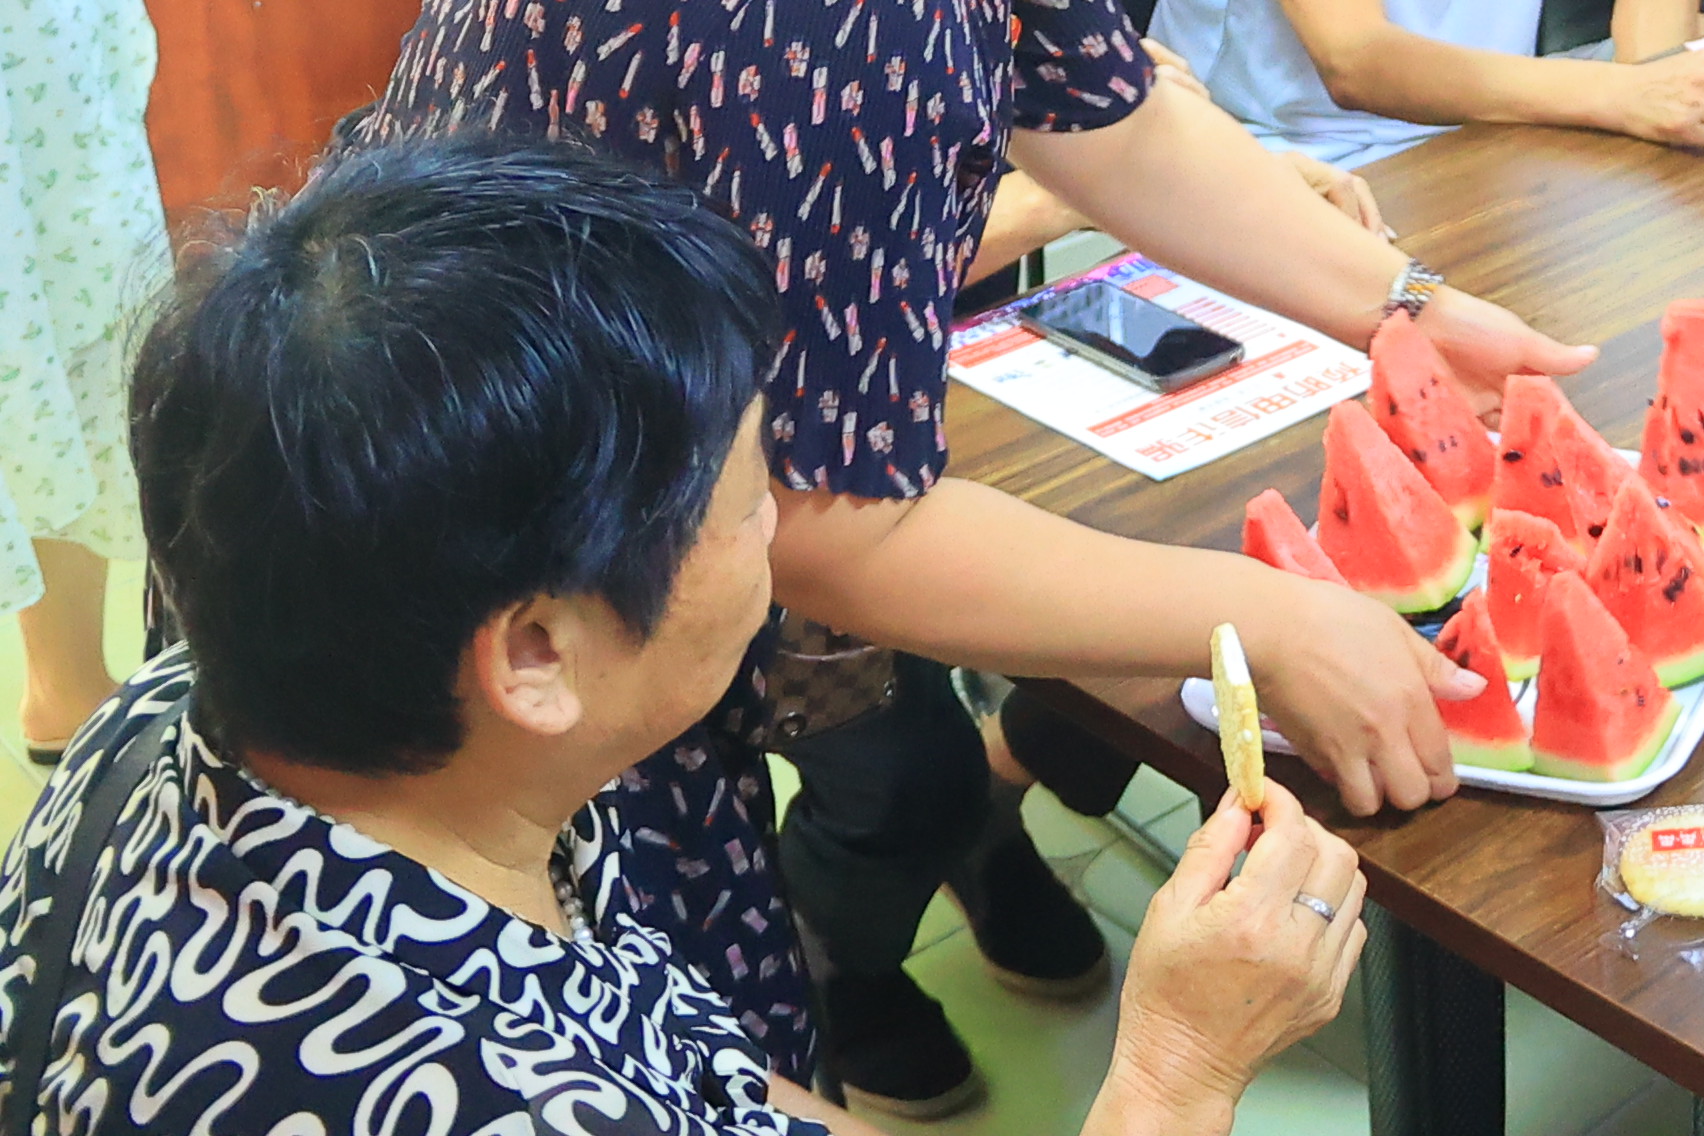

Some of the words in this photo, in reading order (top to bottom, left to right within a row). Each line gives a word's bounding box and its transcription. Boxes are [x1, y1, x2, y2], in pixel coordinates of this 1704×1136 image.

[1135, 360, 1364, 463] 预防电信诈骗
